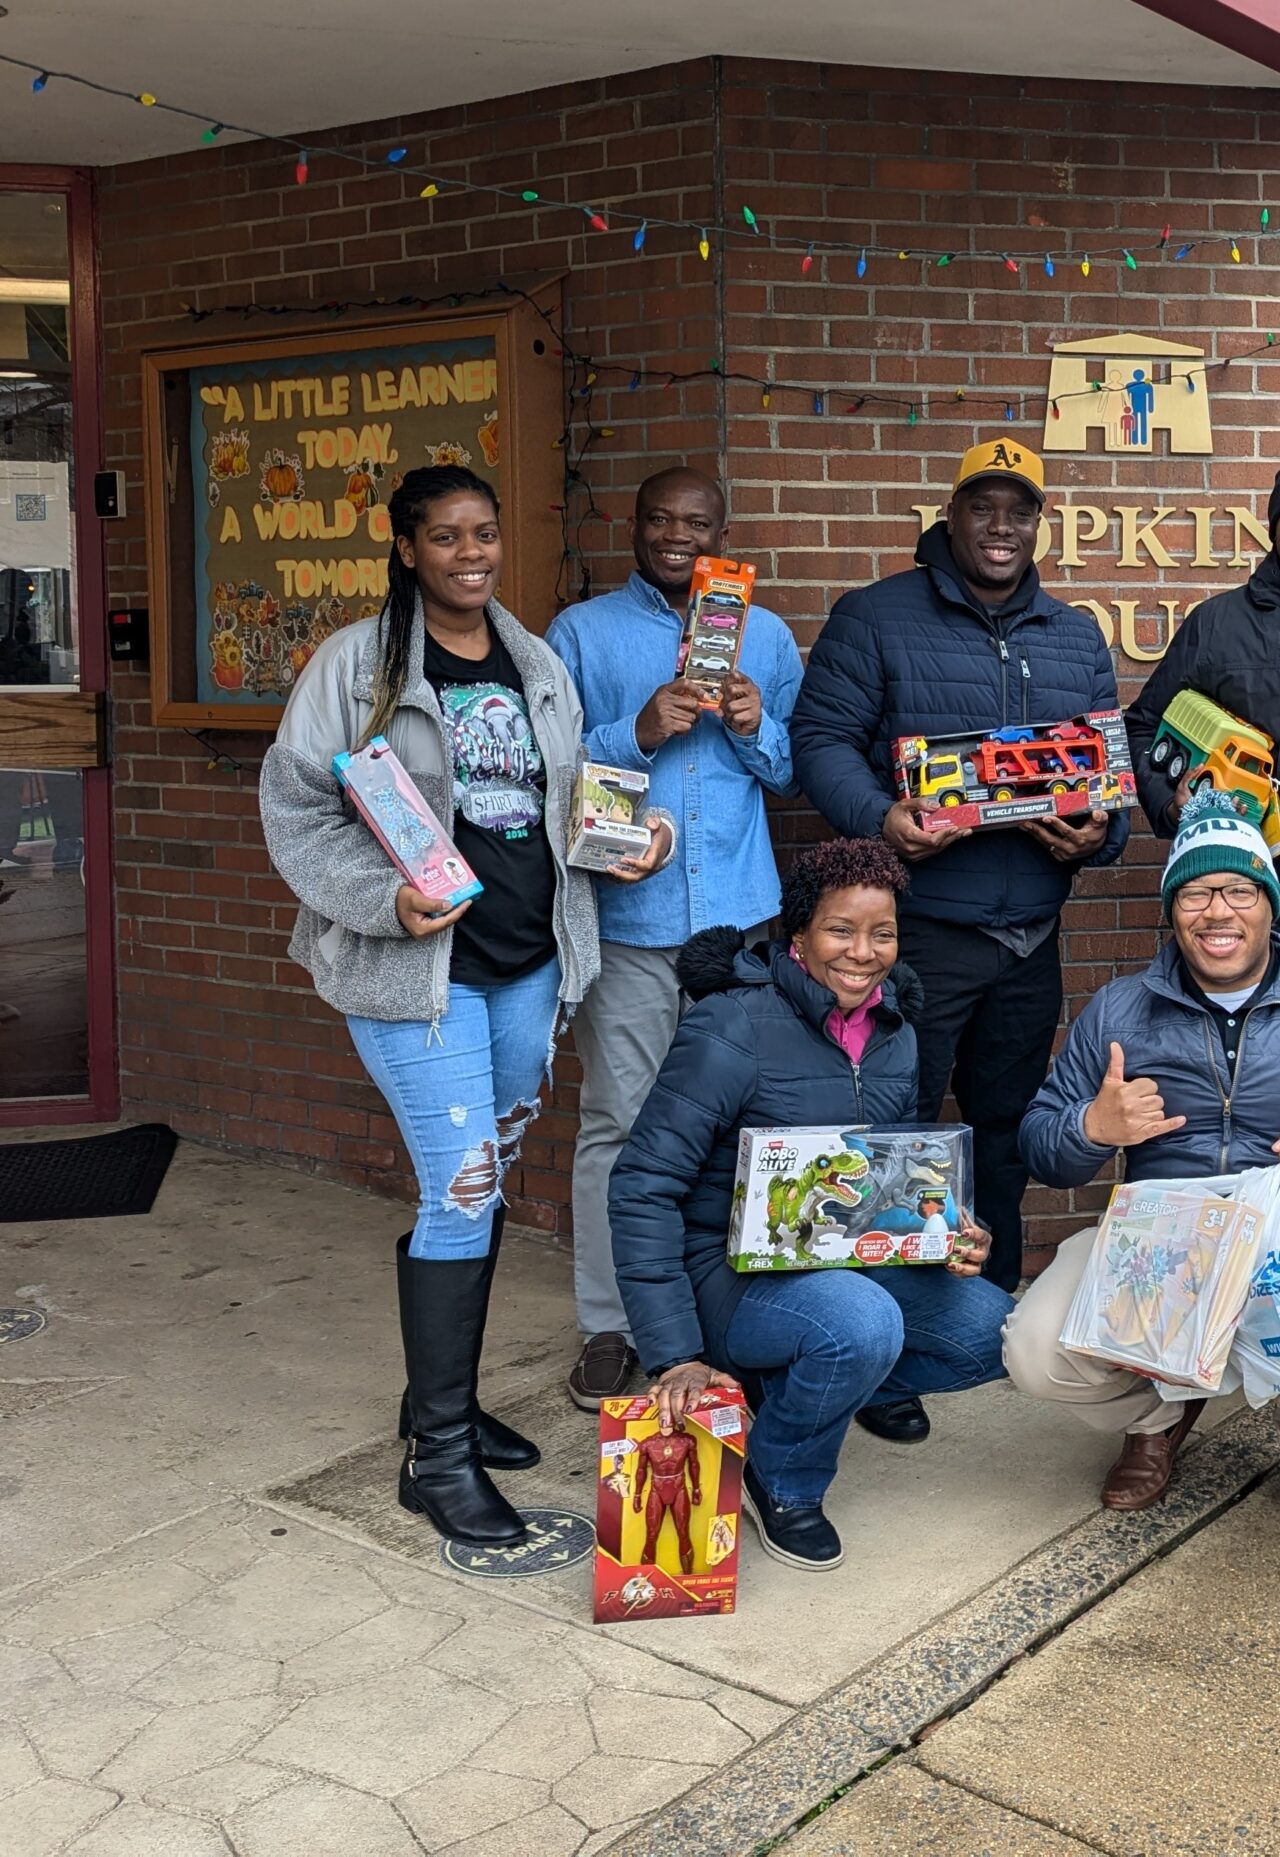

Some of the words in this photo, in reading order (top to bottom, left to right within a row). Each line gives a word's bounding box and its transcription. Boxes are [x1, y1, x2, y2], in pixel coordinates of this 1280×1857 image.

[254, 376, 349, 421] LITTLE
[297, 423, 398, 469] TODAY,
[985, 444, 1021, 468] A's
[220, 506, 241, 543] A
[253, 499, 357, 542] WORLD
[911, 504, 1273, 567] PKIN
[474, 793, 512, 813] SHIRT
[986, 808, 1011, 817] VEHICLE
[1013, 804, 1049, 814] TRANSPORT
[505, 828, 528, 839] 2024
[760, 1147, 798, 1160] ROBO
[758, 1160, 796, 1171] ALIVE
[1133, 1200, 1179, 1216] CREATOR
[1111, 1221, 1122, 1230] 8+
[747, 1260, 773, 1268] T-REX
[503, 1530, 564, 1562] APART
[601, 1587, 676, 1605] FLASH
